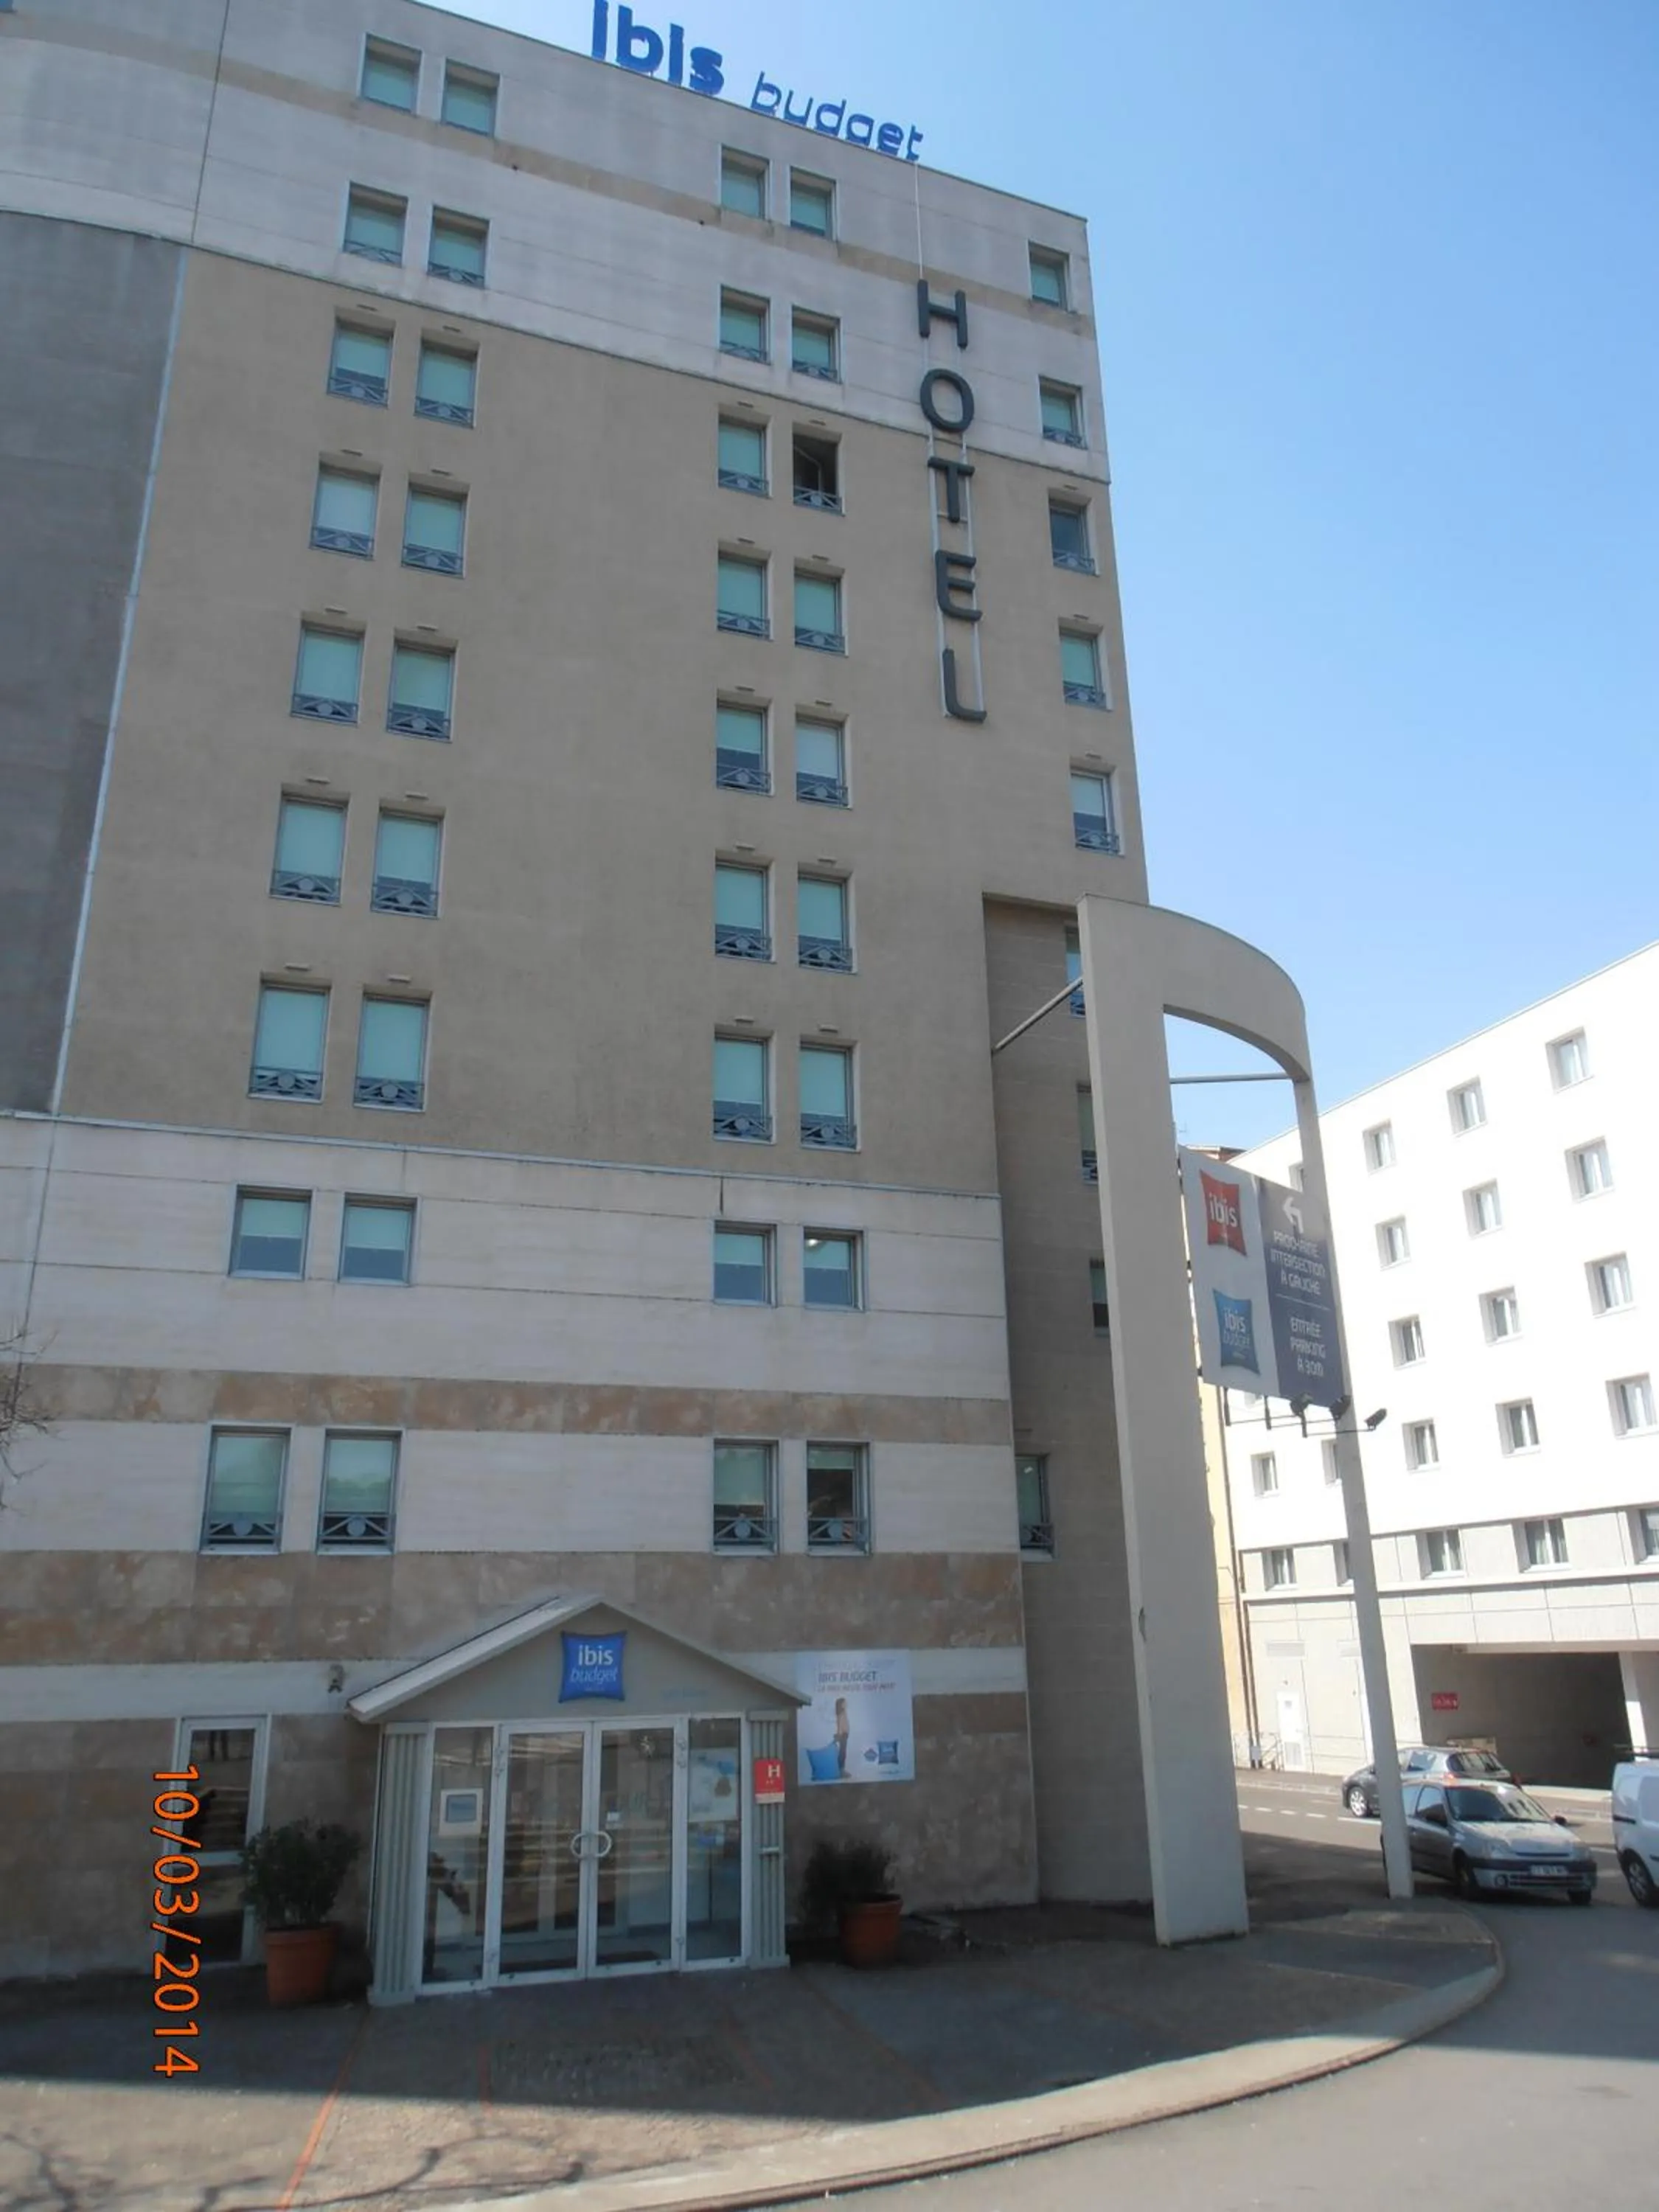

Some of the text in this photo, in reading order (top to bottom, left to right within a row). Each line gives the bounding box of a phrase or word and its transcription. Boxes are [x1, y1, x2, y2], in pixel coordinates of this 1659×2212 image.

[591, 0, 923, 161] ibis budget
[918, 279, 987, 723] HOTEL
[1208, 1191, 1237, 1228] ibis
[1224, 1308, 1246, 1333] ibis
[578, 1644, 614, 1666] ibis
[570, 1666, 619, 1685] budget
[840, 1669, 877, 1683] BUDGET
[768, 1764, 780, 1778] H
